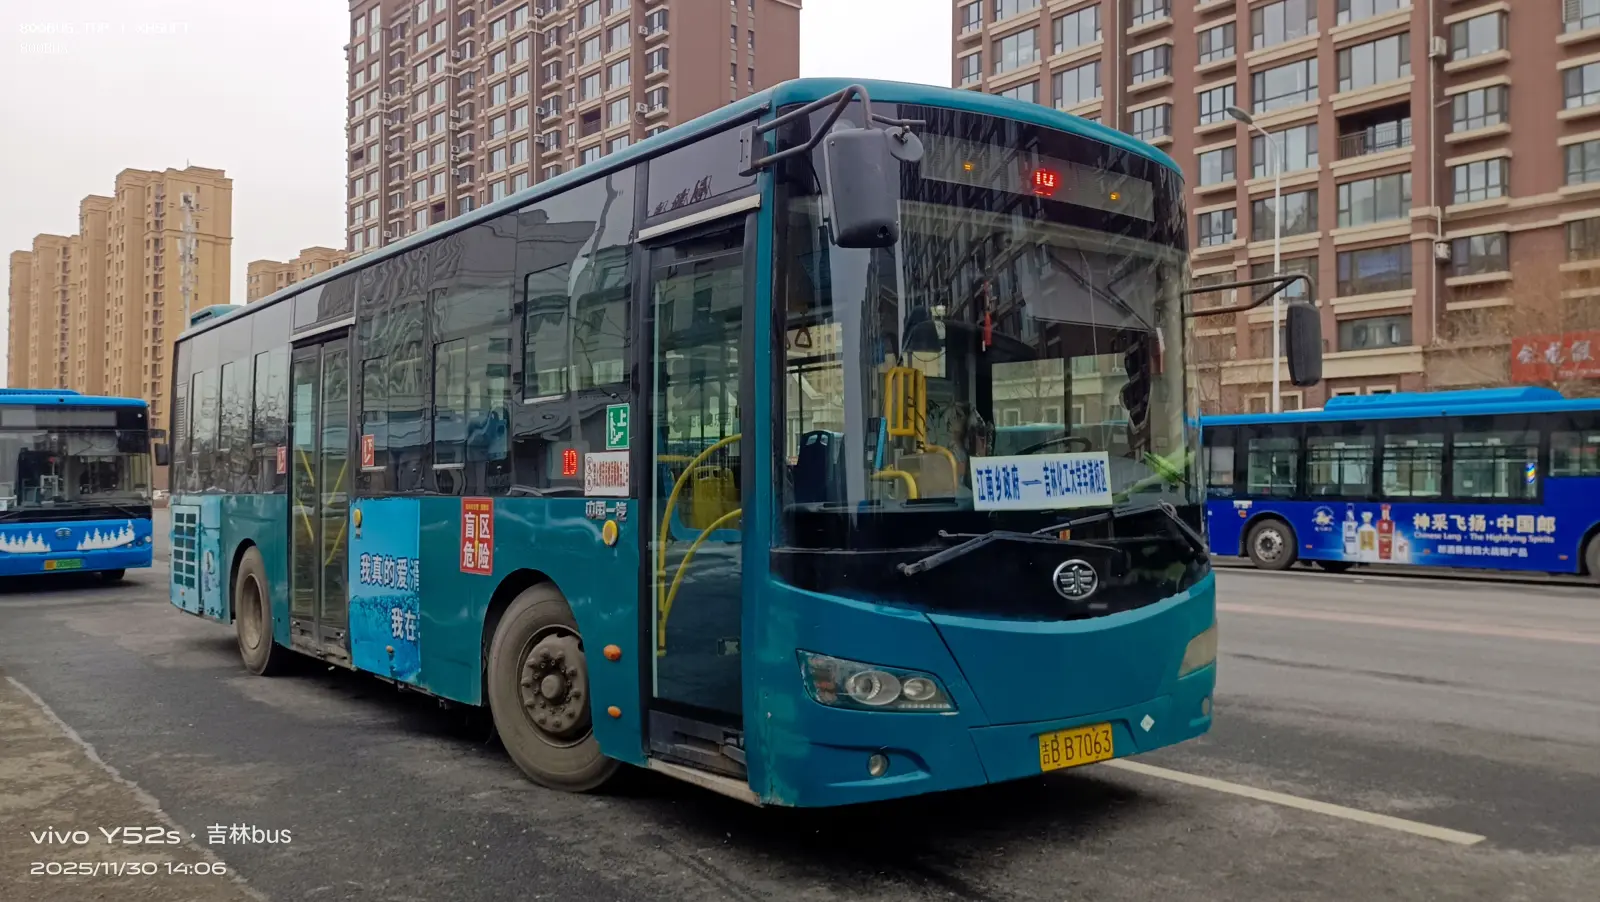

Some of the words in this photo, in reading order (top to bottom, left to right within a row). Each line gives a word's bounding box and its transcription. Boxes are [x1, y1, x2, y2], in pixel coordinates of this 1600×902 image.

[616, 409, 627, 427] 上
[563, 450, 577, 475] 19
[585, 500, 627, 521] 中国一汽
[464, 511, 490, 539] 盲区
[463, 540, 490, 568] 危险
[391, 607, 420, 641] 我在
[1064, 730, 1112, 761] B7063
